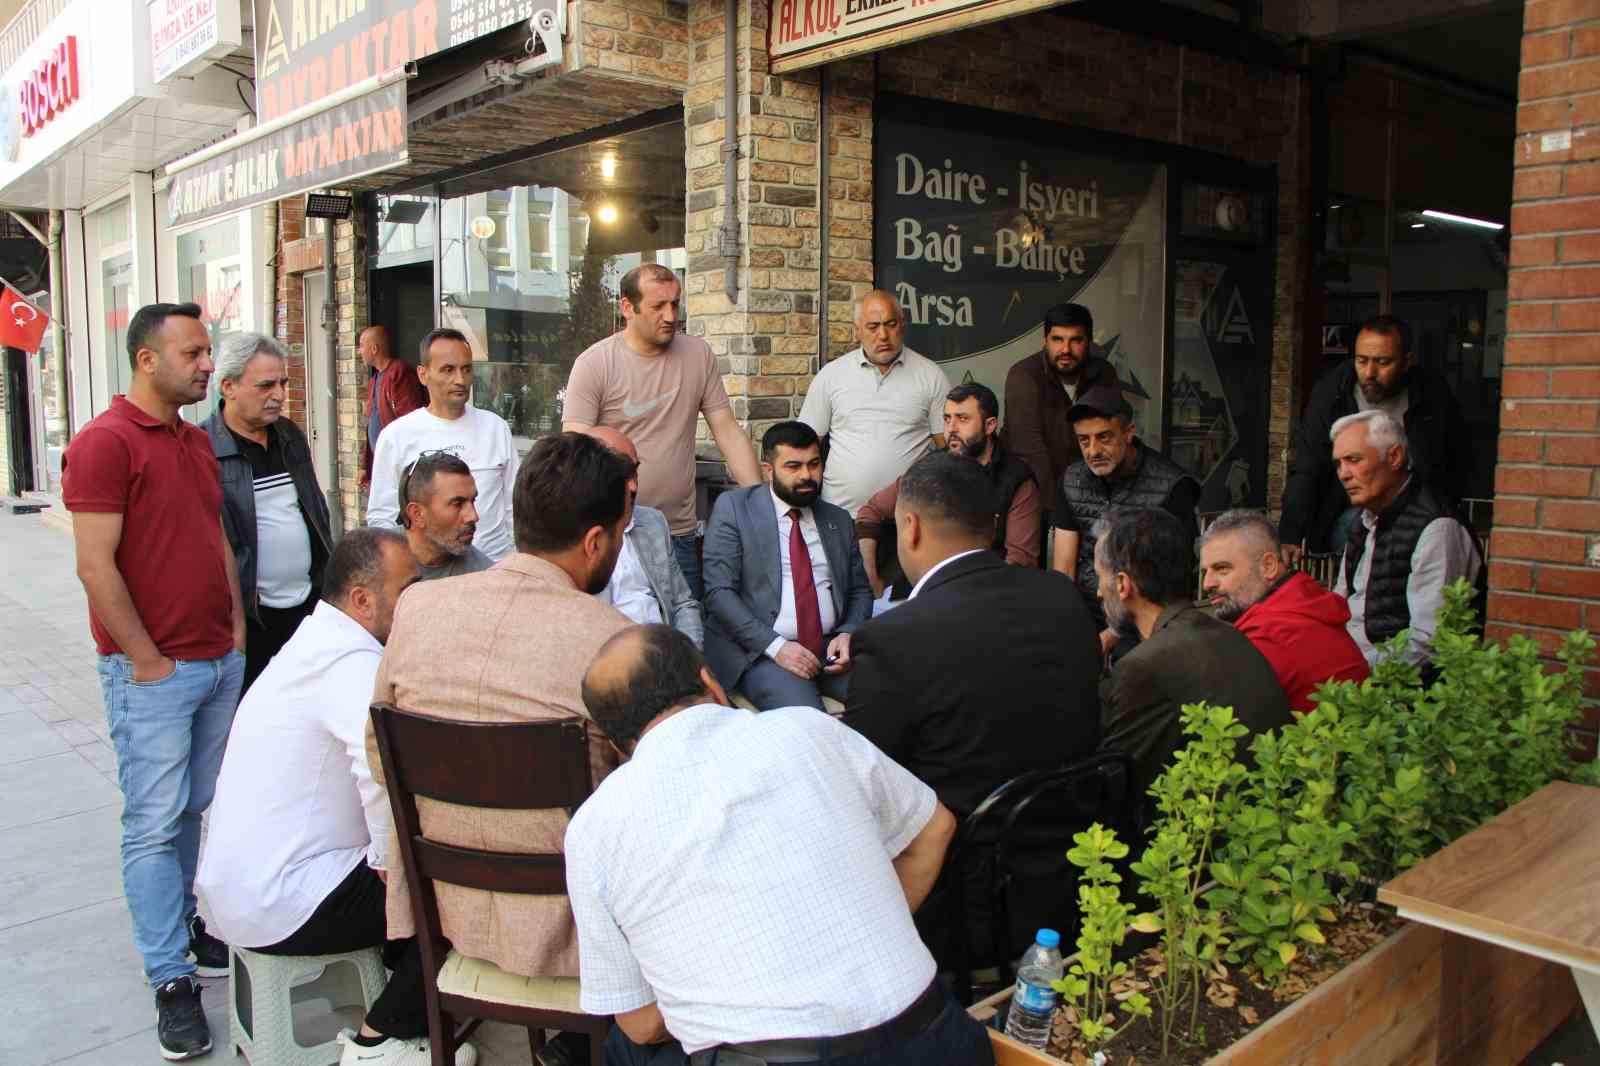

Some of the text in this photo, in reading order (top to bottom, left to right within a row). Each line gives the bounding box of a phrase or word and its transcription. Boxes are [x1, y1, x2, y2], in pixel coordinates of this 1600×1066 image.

[224, 149, 279, 201] EMLAK
[284, 106, 403, 177] BAYRAKTAR
[895, 153, 986, 205] Daire
[1018, 160, 1098, 220] İşyeri
[895, 217, 963, 273] Bağ
[994, 228, 1086, 282] Bahçe
[895, 282, 974, 327] Arsa
